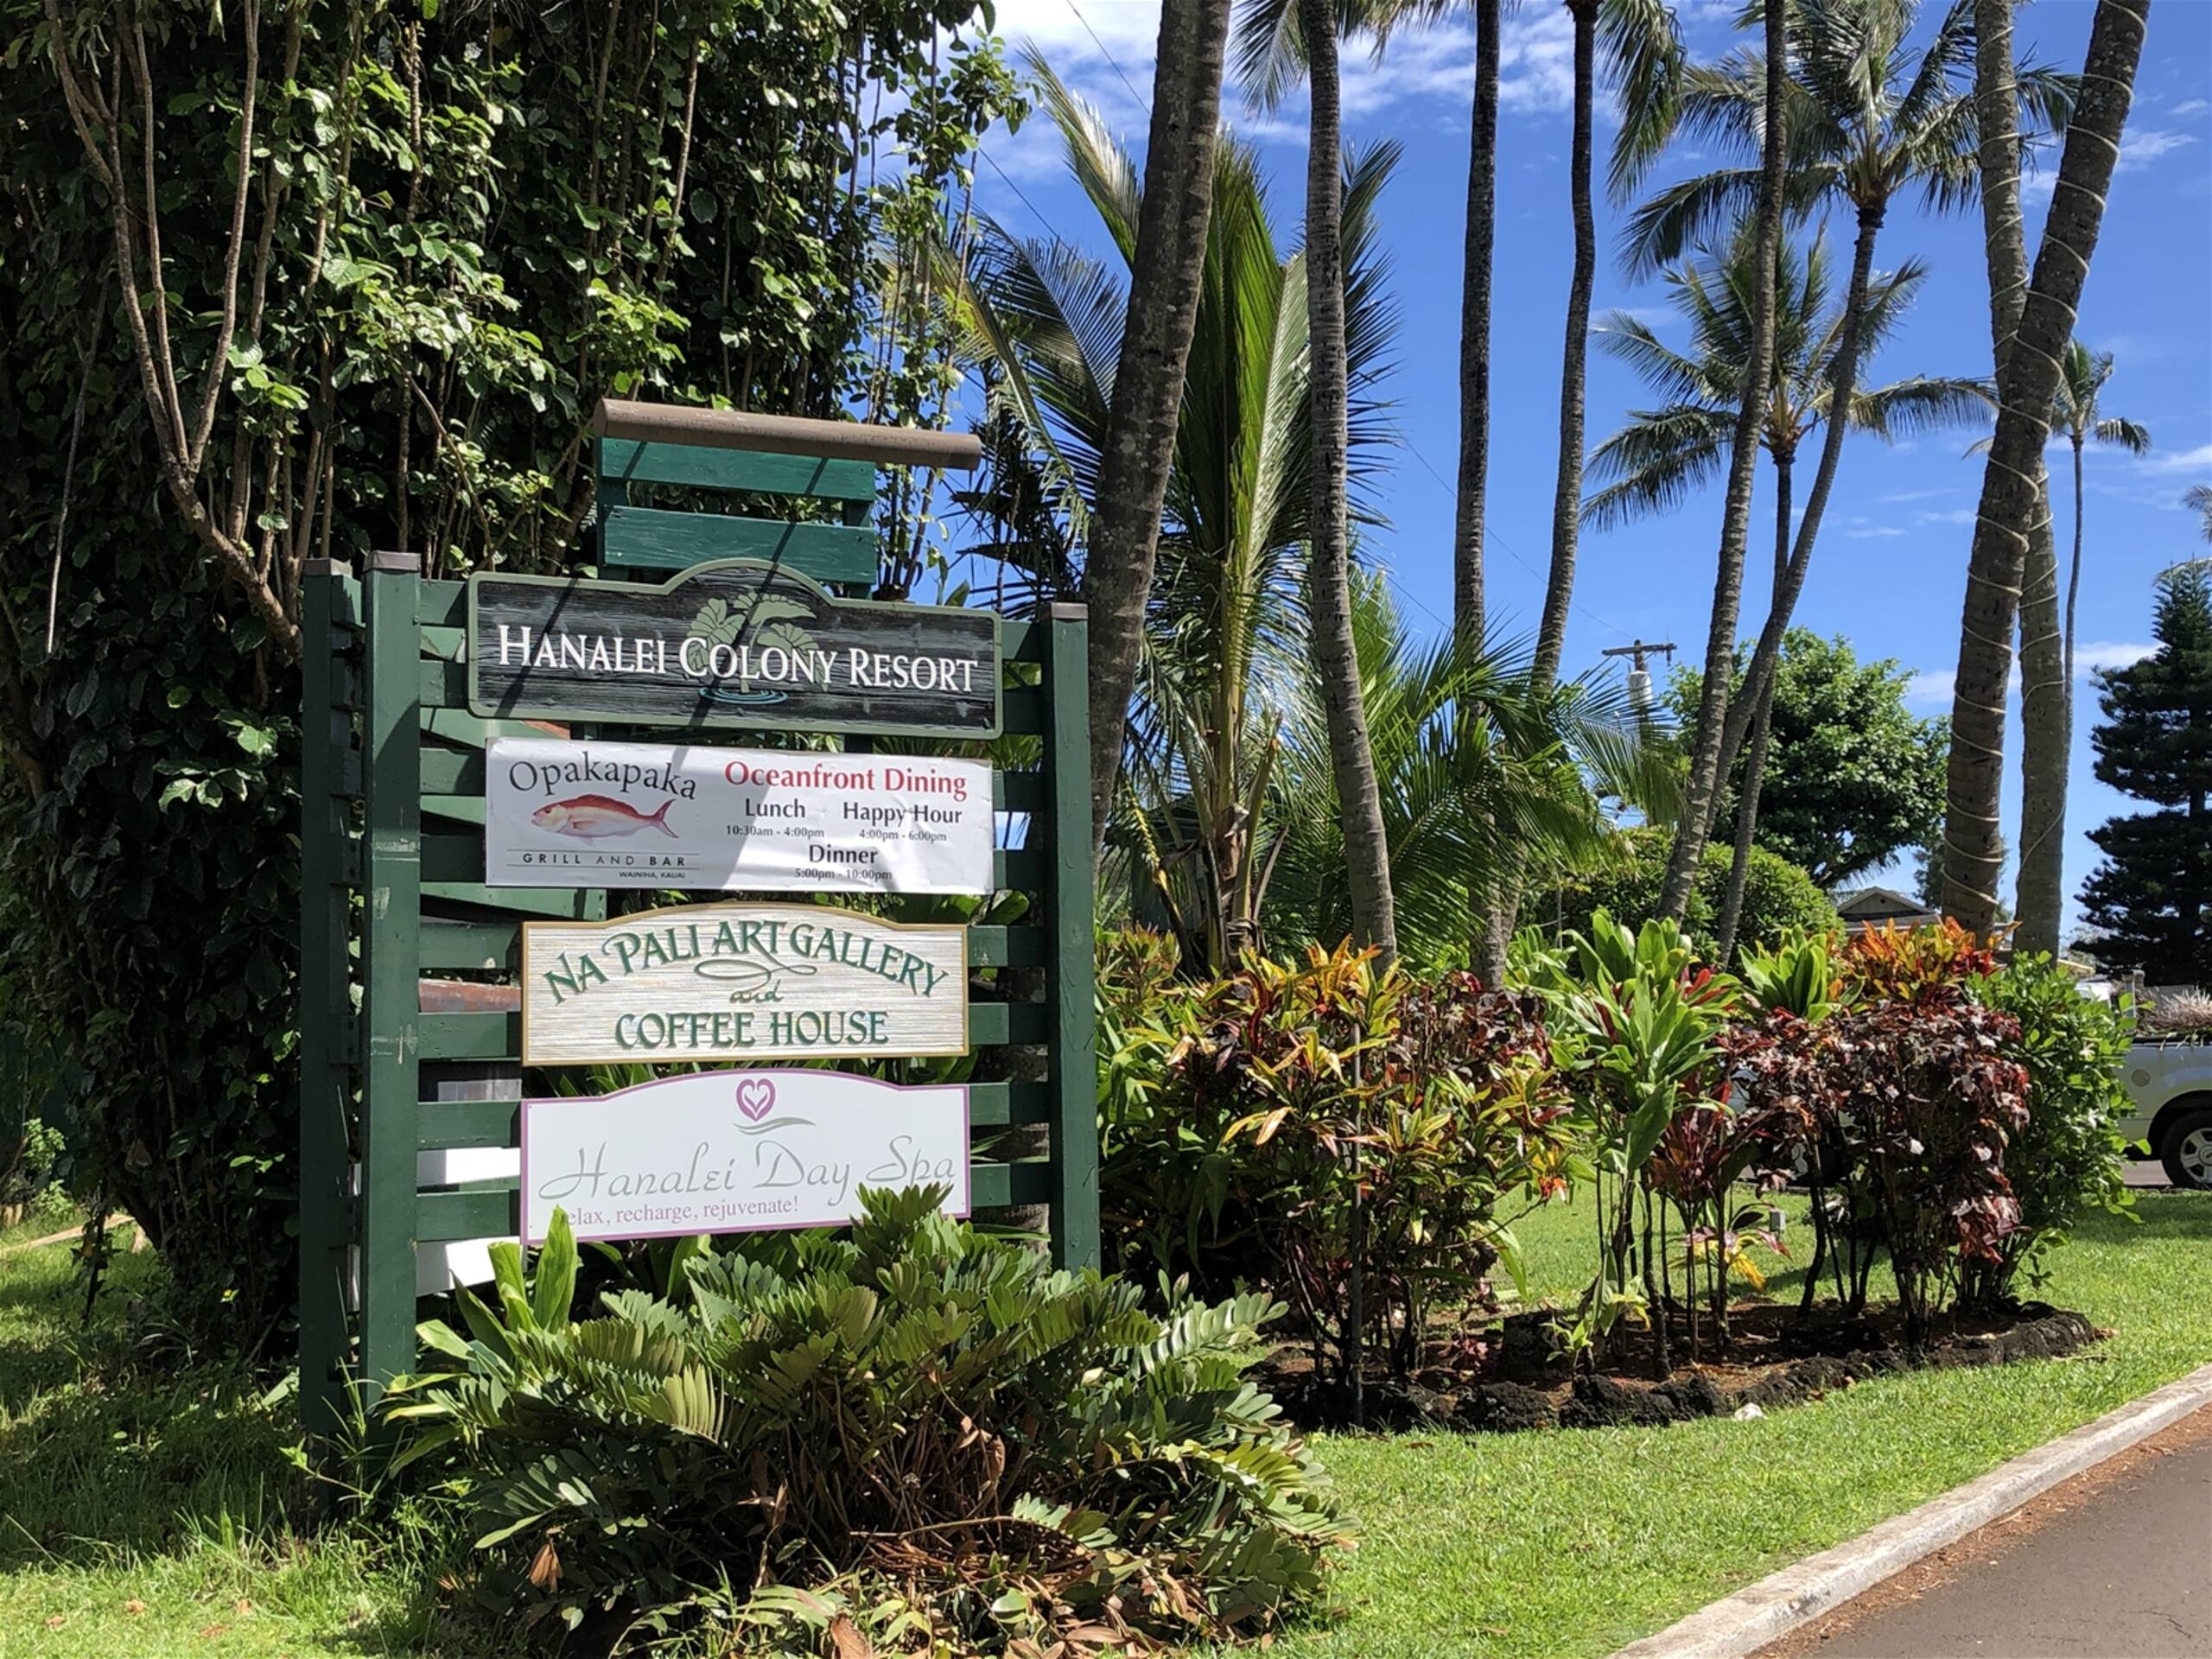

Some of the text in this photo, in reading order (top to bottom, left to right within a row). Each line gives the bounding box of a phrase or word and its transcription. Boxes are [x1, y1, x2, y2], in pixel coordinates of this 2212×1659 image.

[498, 625, 980, 693] HANALEI COLONY RESORT
[509, 751, 696, 800] Opakapaka
[725, 760, 967, 802] Oceanfront Dining
[745, 798, 805, 818] Lunch
[842, 801, 963, 828] Happy Hour
[726, 824, 773, 837] 10:30am
[784, 827, 824, 838] 4:00pm
[859, 829, 899, 841] 4:00pm
[908, 830, 947, 842] 6:00pm
[522, 853, 685, 867] GRILL AND BAR
[809, 844, 878, 863] Dinner
[794, 868, 836, 880] 5:00pm
[846, 869, 893, 880] 10:00pm
[543, 919, 950, 1006] NA PALI ART GALLERY
[728, 979, 785, 1004] and
[614, 1009, 890, 1050] COFFEE HOUSE
[538, 1134, 957, 1207] Hanalei Day Spa
[560, 1196, 800, 1226] elax, recharge, rejuvenate!
